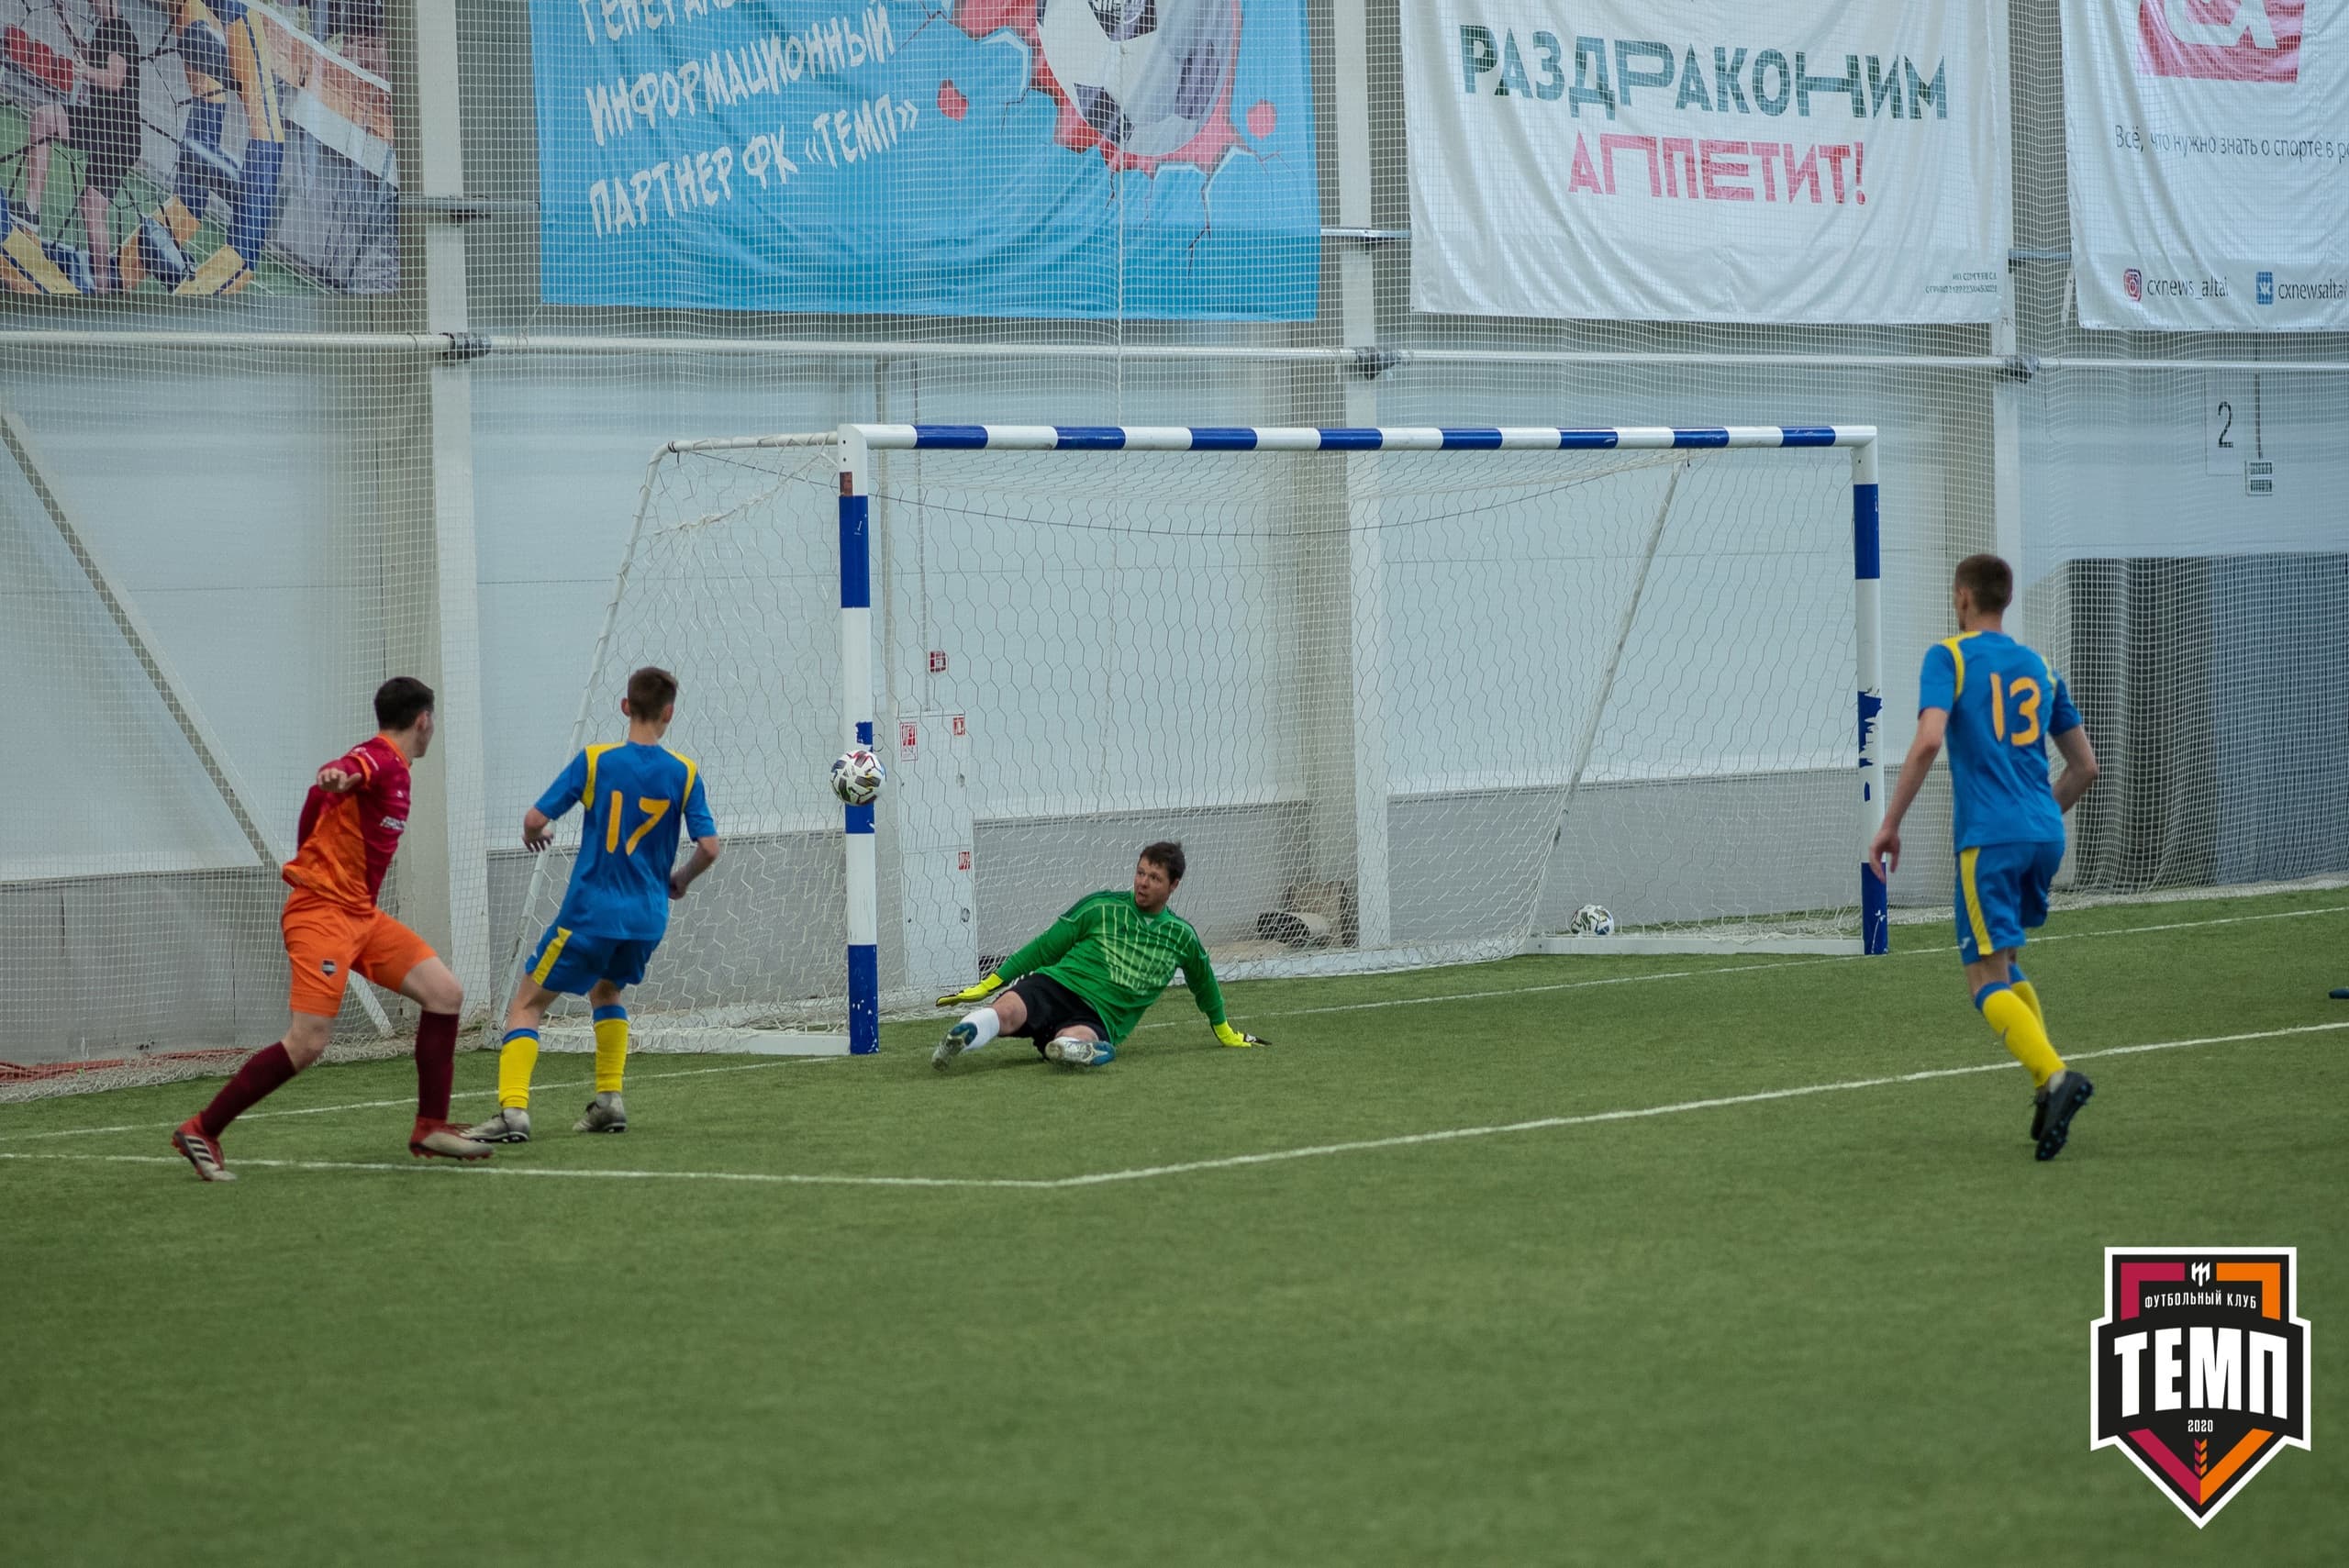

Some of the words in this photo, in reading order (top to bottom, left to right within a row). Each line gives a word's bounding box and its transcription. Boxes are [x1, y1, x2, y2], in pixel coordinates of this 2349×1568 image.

[585, 1, 894, 146] ИНФОРМАЦИОННЫЙ
[1460, 24, 1948, 120] РАЗДРАКОНИМ
[589, 146, 733, 239] ПАРТНЕР
[741, 125, 798, 189] ФК
[804, 95, 918, 170] «ТЕМП»
[1568, 130, 1865, 205] АППЕТИТ!
[2151, 132, 2170, 150] что
[2173, 135, 2217, 157] нужно
[2221, 138, 2258, 155] знать
[2261, 139, 2270, 156] о
[2274, 139, 2323, 163] спорте
[2326, 140, 2333, 158] в
[2218, 401, 2233, 448] 2
[1990, 673, 2041, 746] 13
[606, 790, 671, 856] 17
